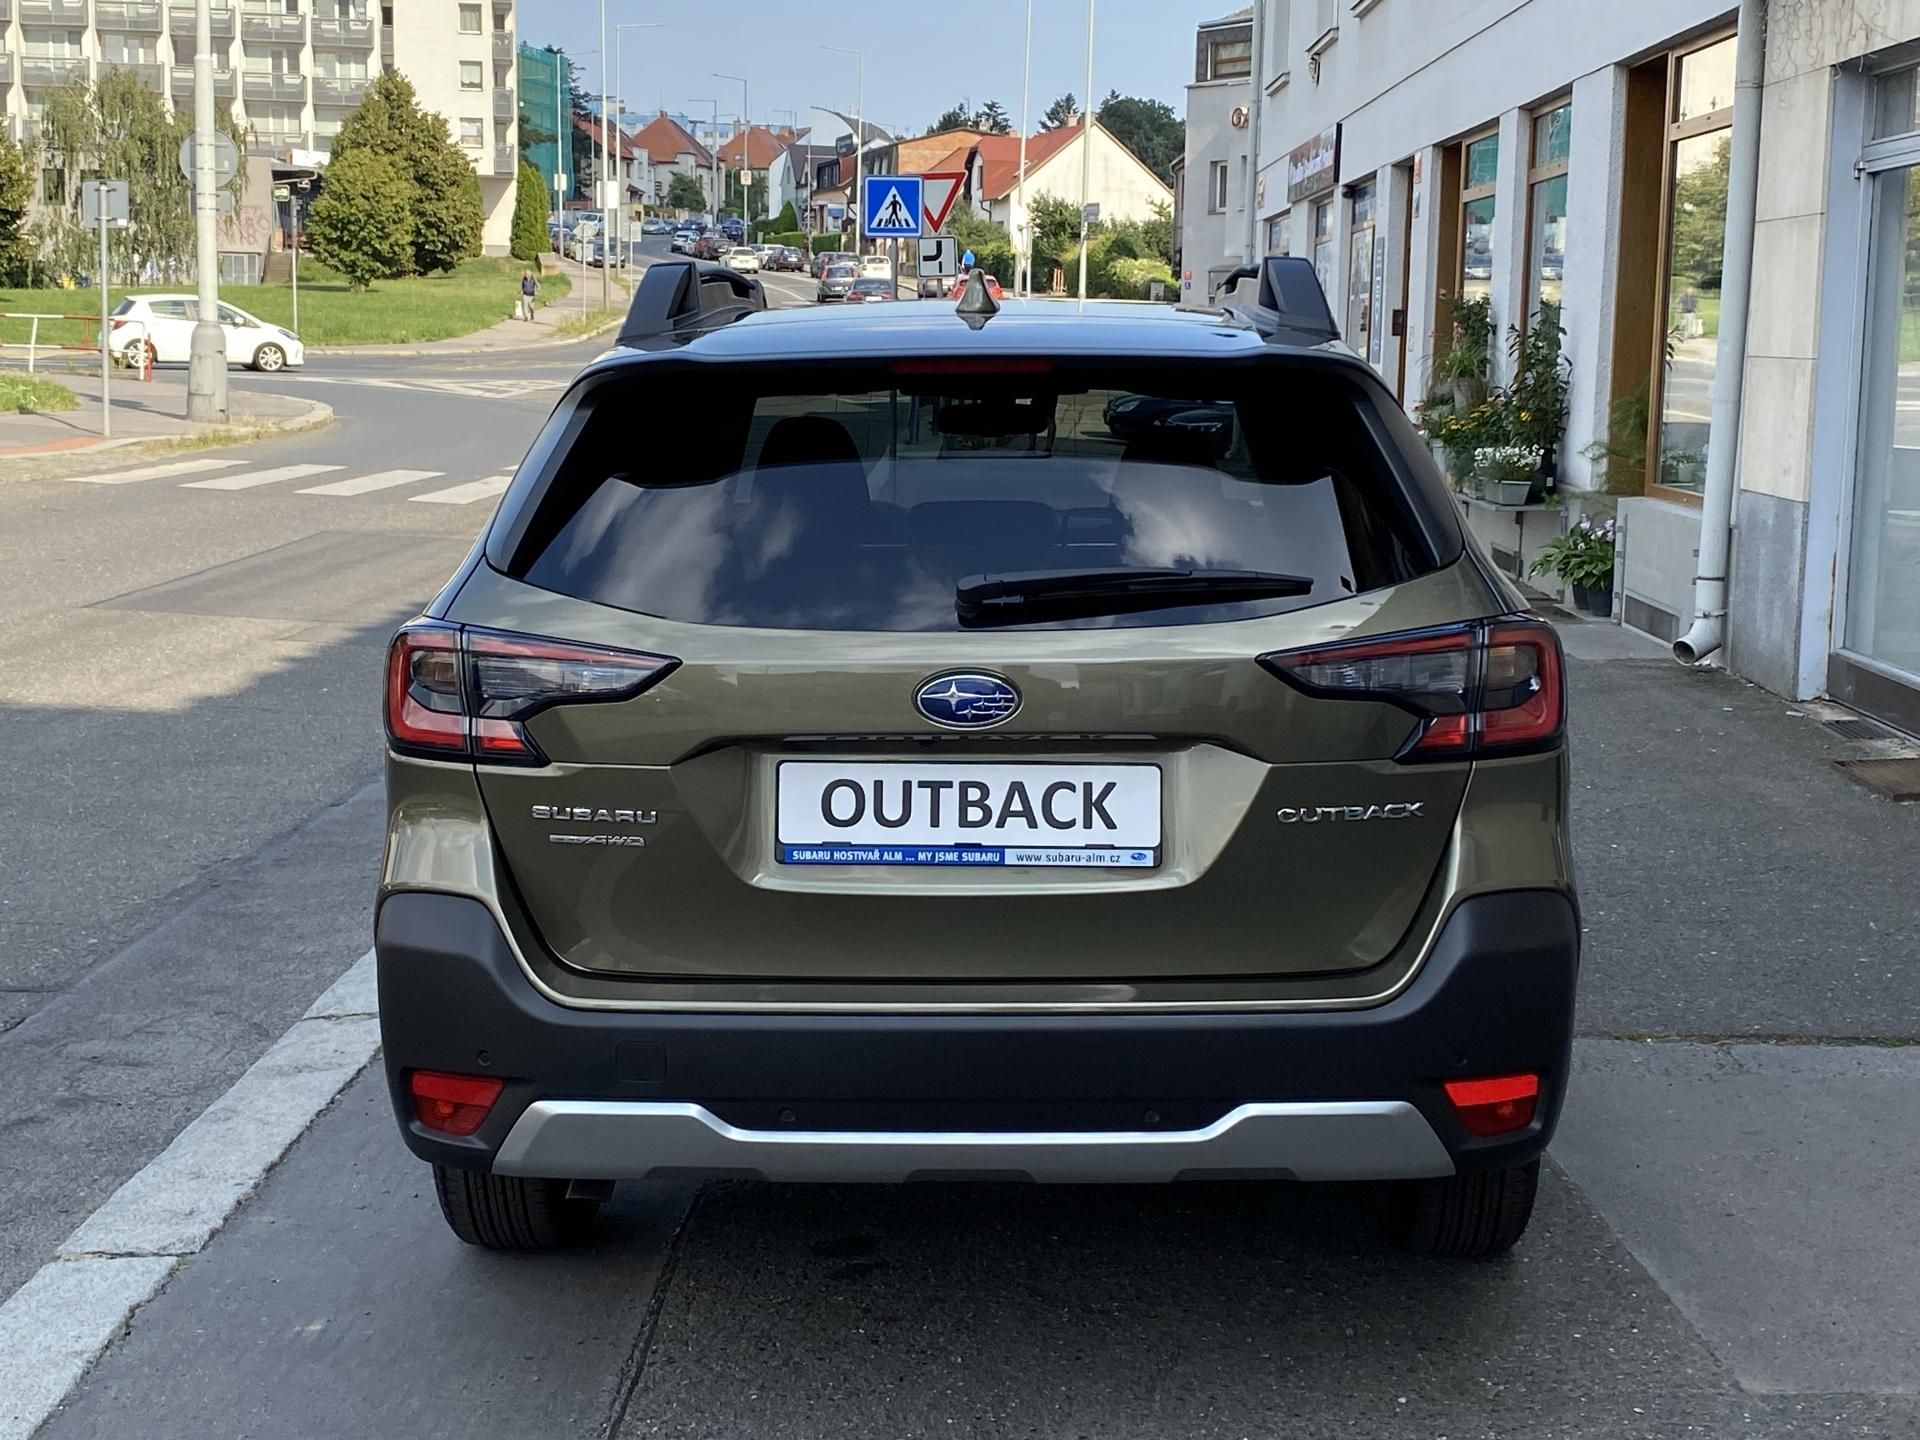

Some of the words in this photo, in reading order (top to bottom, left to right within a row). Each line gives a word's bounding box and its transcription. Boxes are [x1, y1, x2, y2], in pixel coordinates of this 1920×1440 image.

[531, 804, 657, 824] SUBARU
[820, 778, 1118, 830] OUTBACK
[1276, 802, 1425, 823] OUTBACK
[792, 850, 831, 860] SUBARU
[833, 848, 880, 861] HOSTIVAŘ
[882, 851, 903, 861] ALM
[917, 852, 933, 861] MY
[935, 852, 959, 863] JSME
[961, 852, 1000, 862] SUBARU
[1016, 852, 1121, 863] www.subaru-alm.cz
